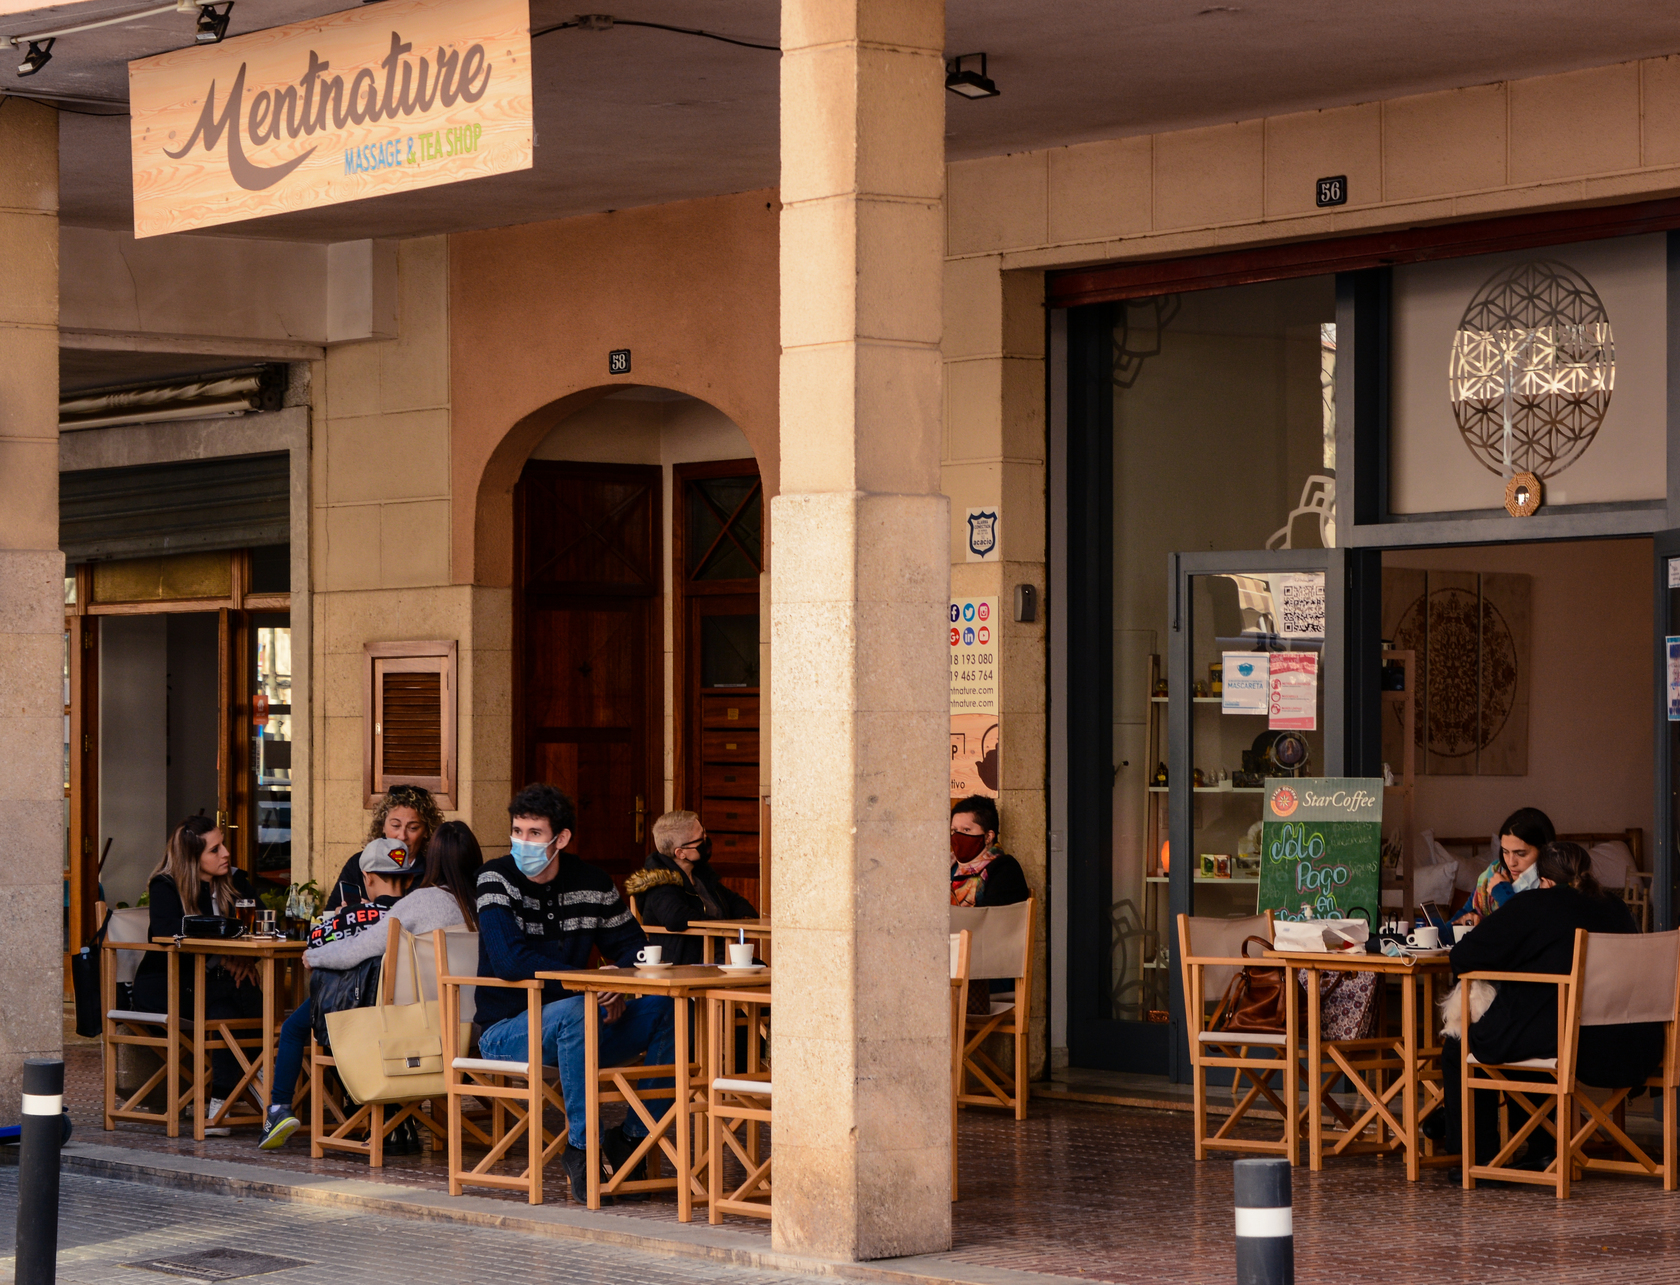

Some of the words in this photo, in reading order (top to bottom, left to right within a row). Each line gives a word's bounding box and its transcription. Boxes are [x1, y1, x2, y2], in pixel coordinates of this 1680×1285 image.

[163, 31, 491, 191] Mentnature
[344, 139, 402, 175] MASSAGE
[407, 136, 417, 164] &
[418, 130, 443, 161] TEA
[446, 123, 482, 156] SHOP
[1320, 181, 1340, 202] 56
[612, 353, 626, 370] 58
[962, 654, 976, 665] 193
[978, 653, 993, 665] 080
[961, 670, 976, 681] 465
[979, 669, 993, 681] 764
[1228, 682, 1264, 690] MASCARETA
[1302, 790, 1376, 812] StarCoffee
[1297, 861, 1348, 896] Pago
